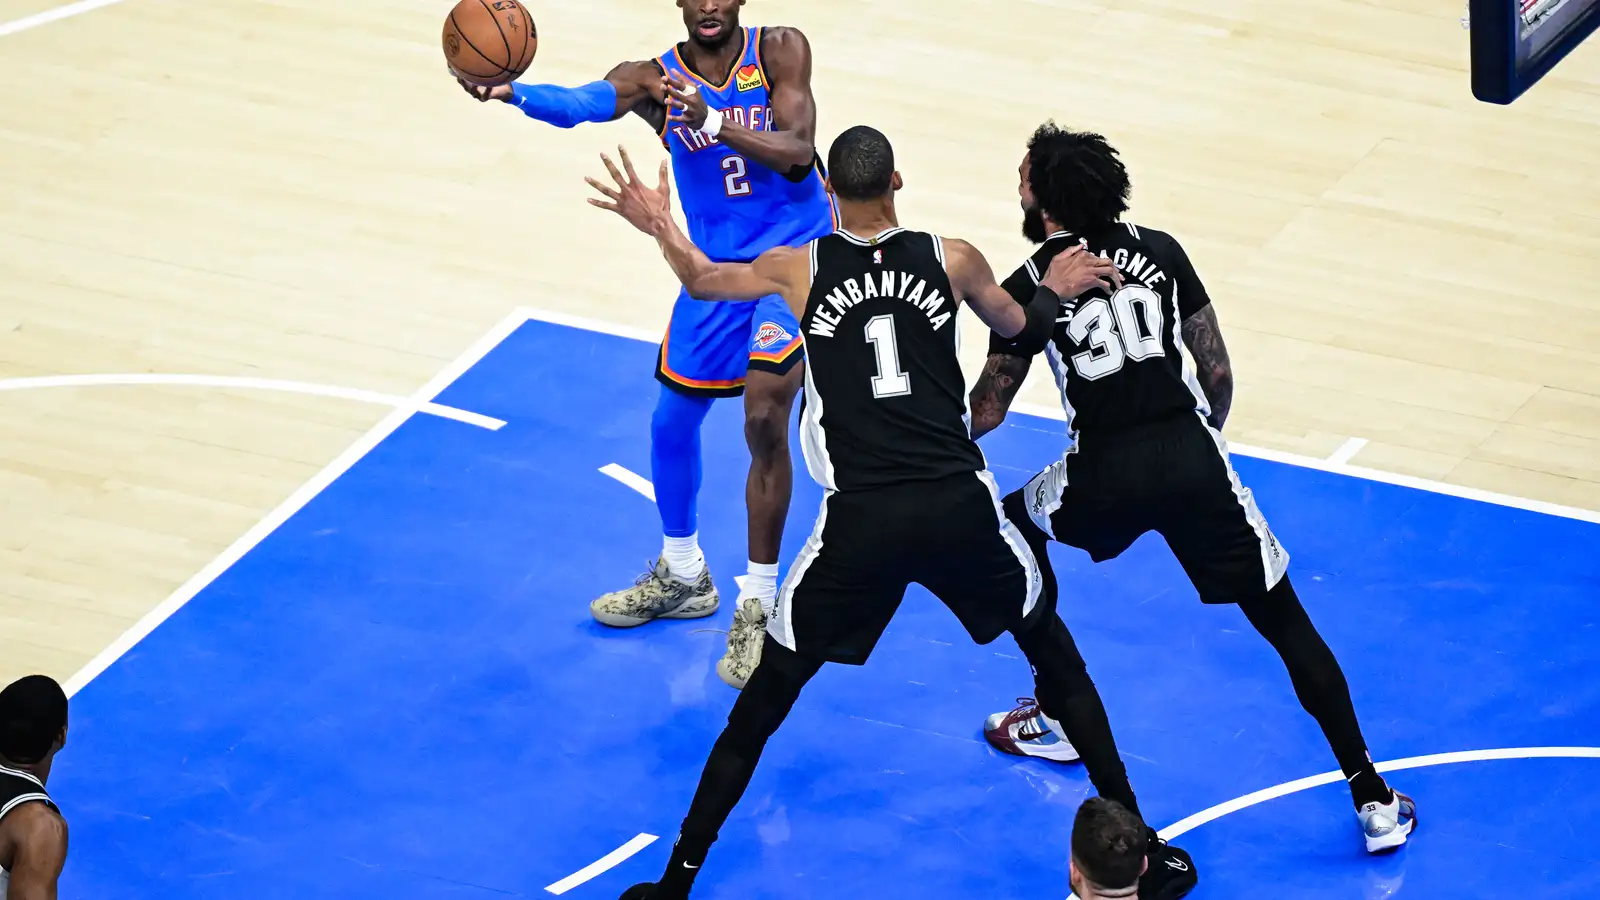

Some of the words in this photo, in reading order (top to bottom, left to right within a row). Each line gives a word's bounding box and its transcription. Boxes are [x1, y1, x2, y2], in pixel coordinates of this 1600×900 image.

[721, 154, 752, 197] 2
[809, 270, 951, 338] WEMBANYAMA
[1066, 283, 1166, 382] 30
[864, 313, 912, 399] 1
[1366, 803, 1377, 812] 33
